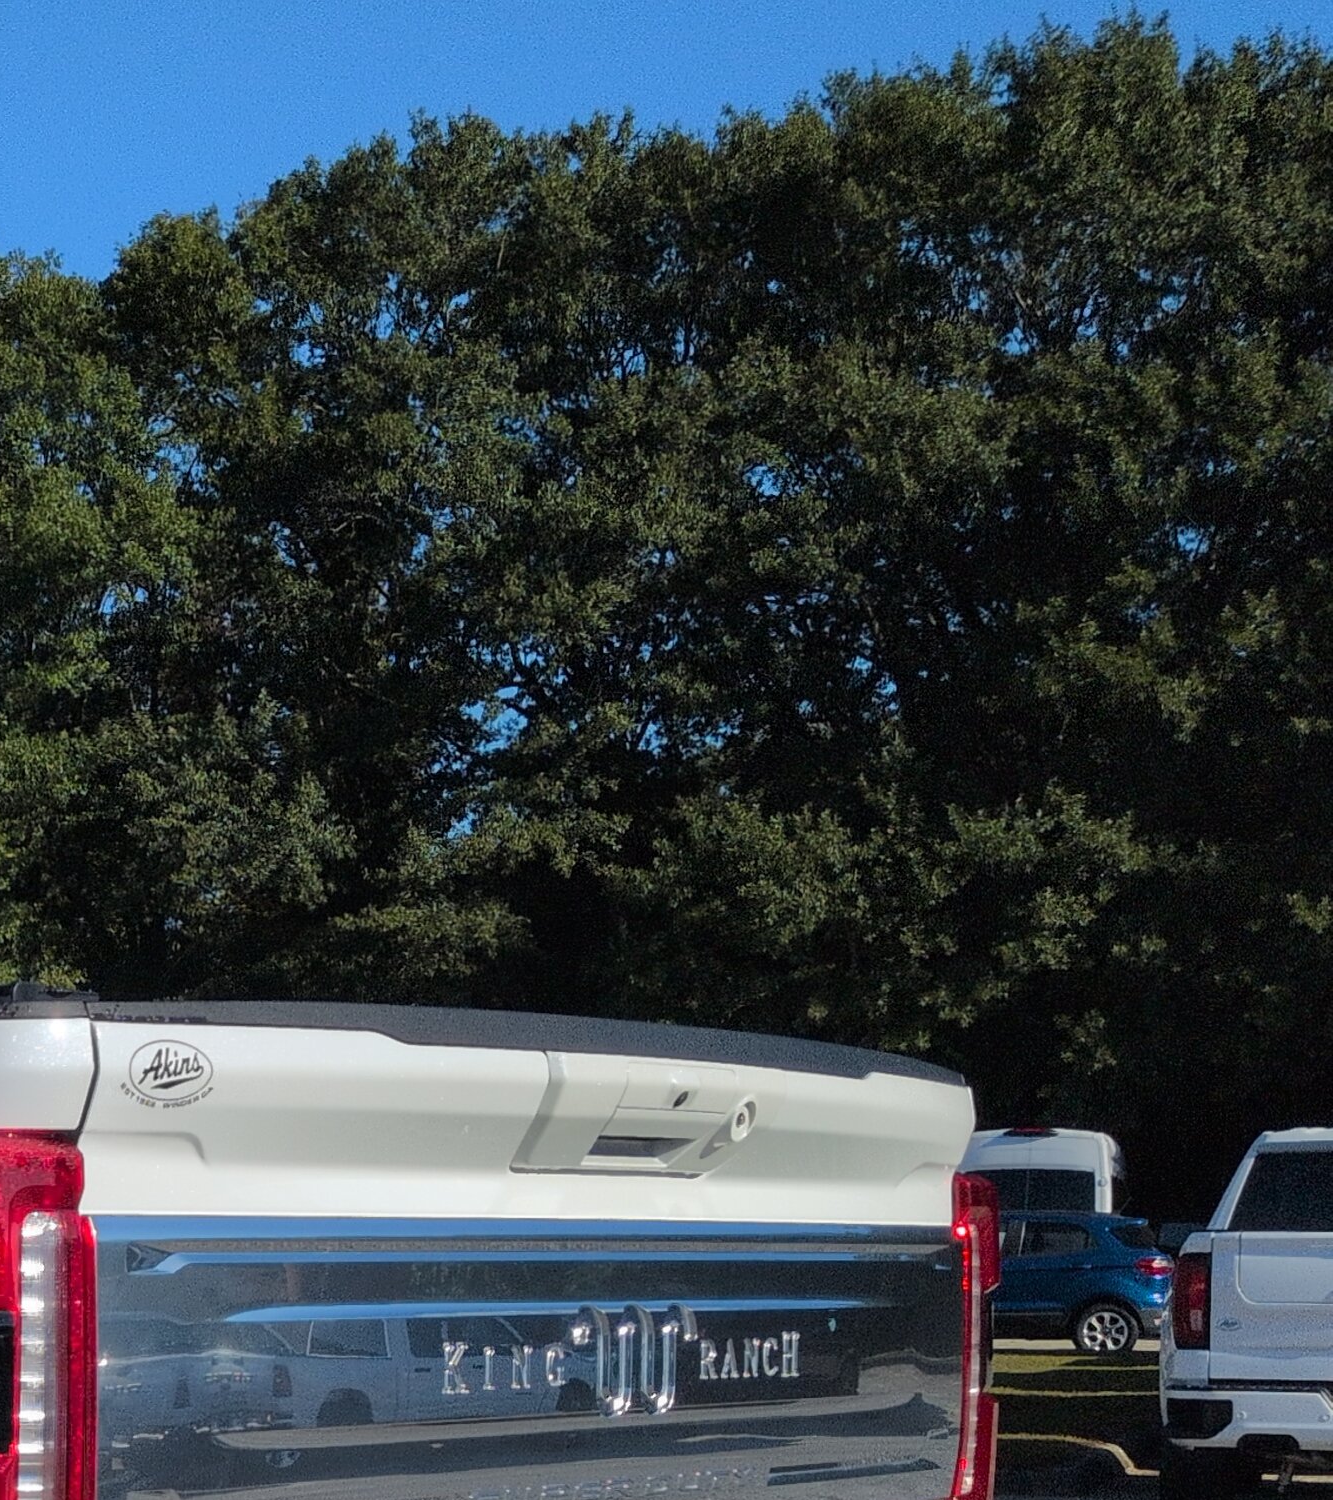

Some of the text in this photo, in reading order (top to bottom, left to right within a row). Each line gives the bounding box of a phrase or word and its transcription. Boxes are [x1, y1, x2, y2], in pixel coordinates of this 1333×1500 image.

[138, 1047, 204, 1088] Akins
[441, 1330, 802, 1394] KING RANCH
